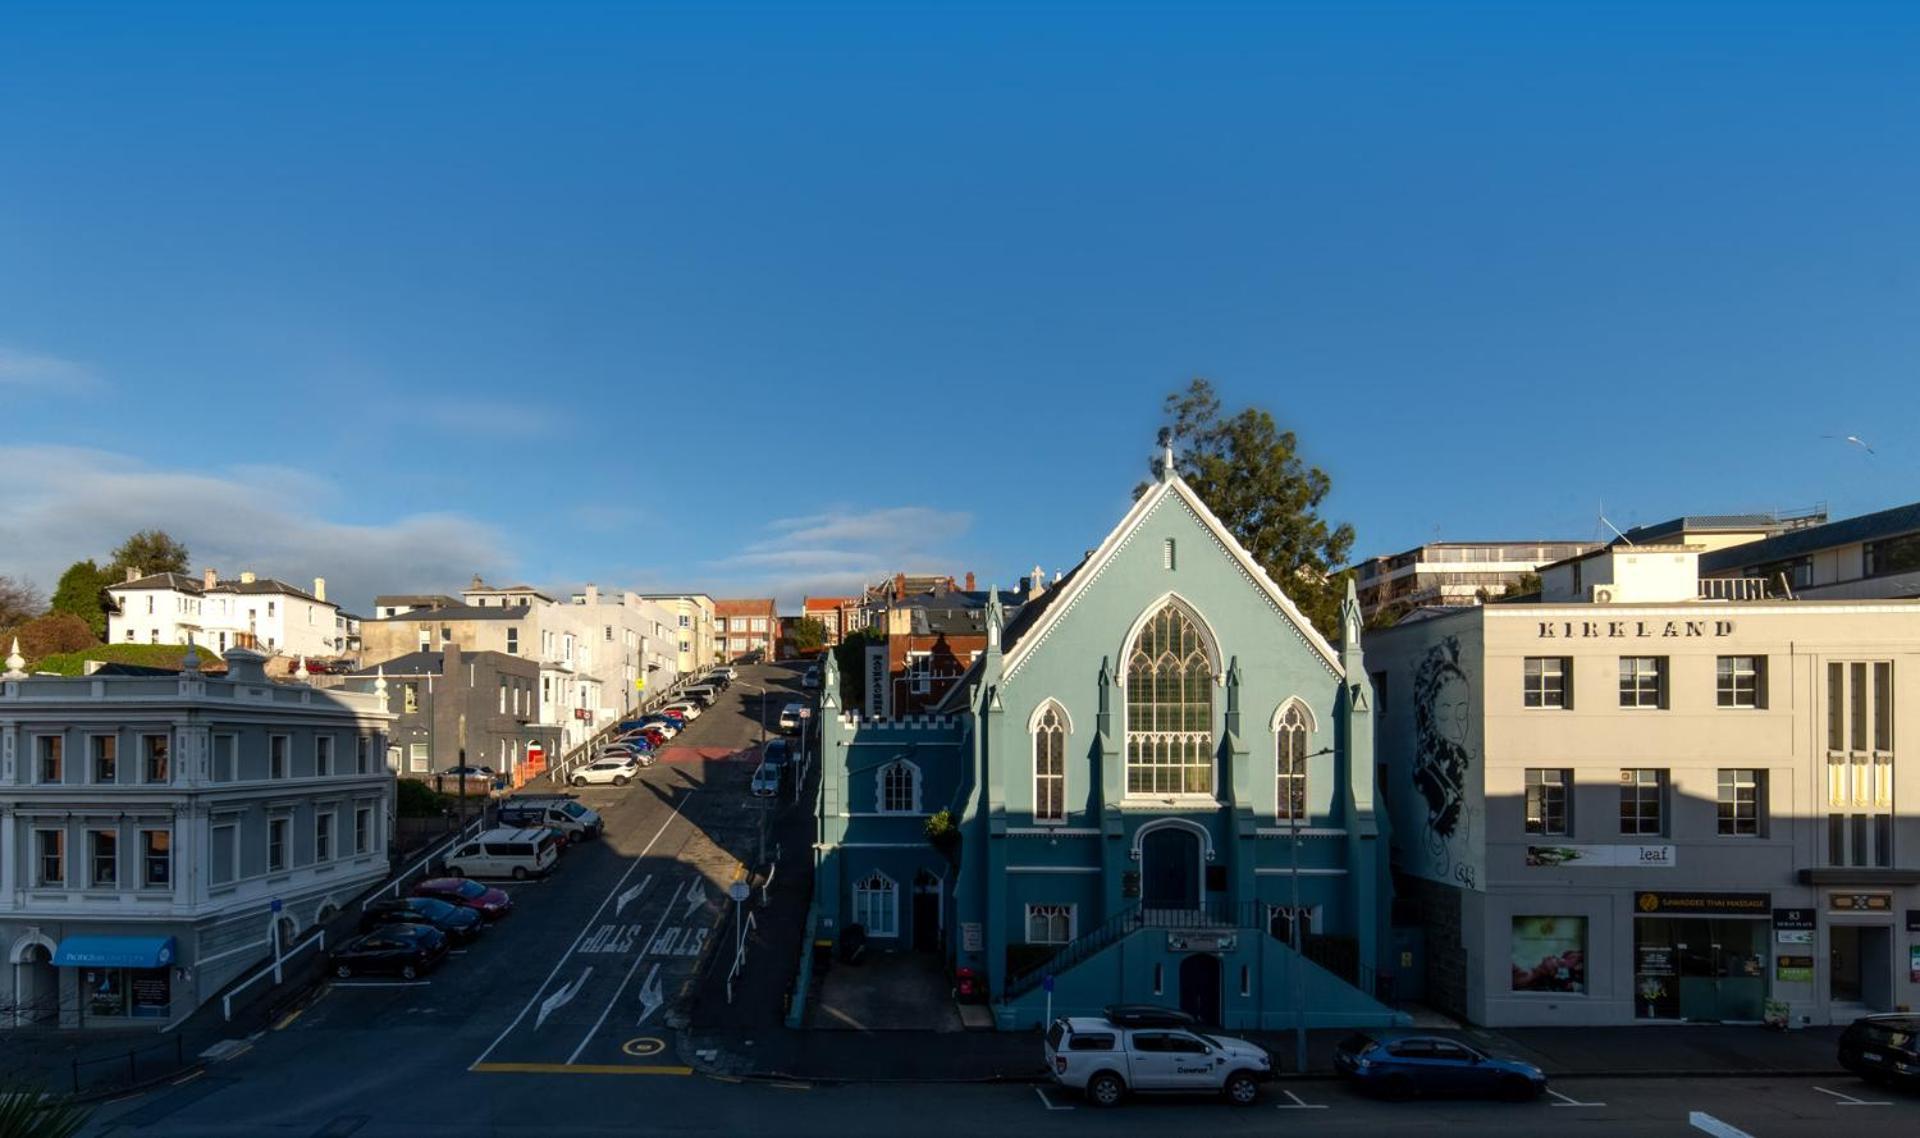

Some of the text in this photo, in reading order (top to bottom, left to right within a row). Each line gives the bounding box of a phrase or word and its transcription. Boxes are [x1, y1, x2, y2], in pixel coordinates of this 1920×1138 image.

[1538, 621, 1734, 638] KIRKLAND
[1640, 846, 1668, 860] leaf
[577, 924, 642, 952] STOP
[650, 927, 708, 955] STOP
